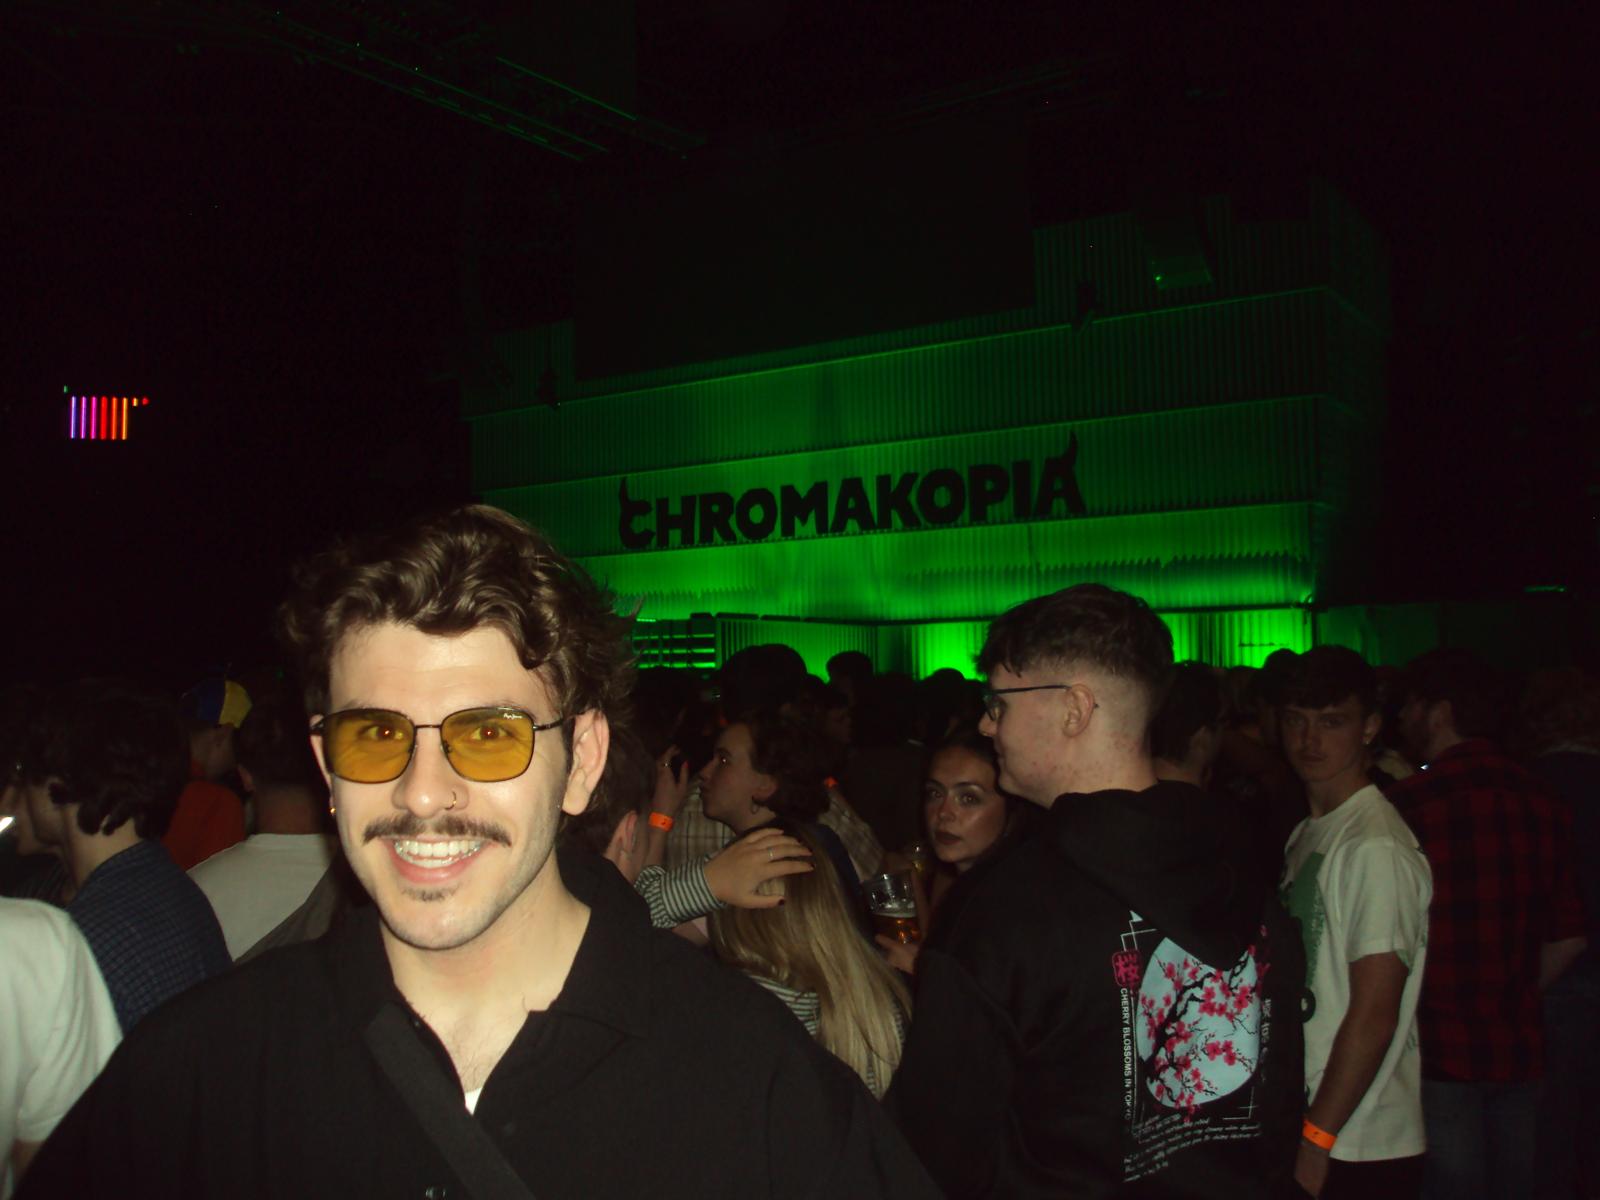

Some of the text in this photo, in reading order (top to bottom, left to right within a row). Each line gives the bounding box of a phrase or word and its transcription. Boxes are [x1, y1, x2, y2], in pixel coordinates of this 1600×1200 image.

[618, 431, 1086, 550] CHROMAKOPIA
[1120, 987, 1130, 1025] CHERRY
[1122, 1027, 1132, 1077] BLOSSOMS
[1124, 1079, 1132, 1088] IN
